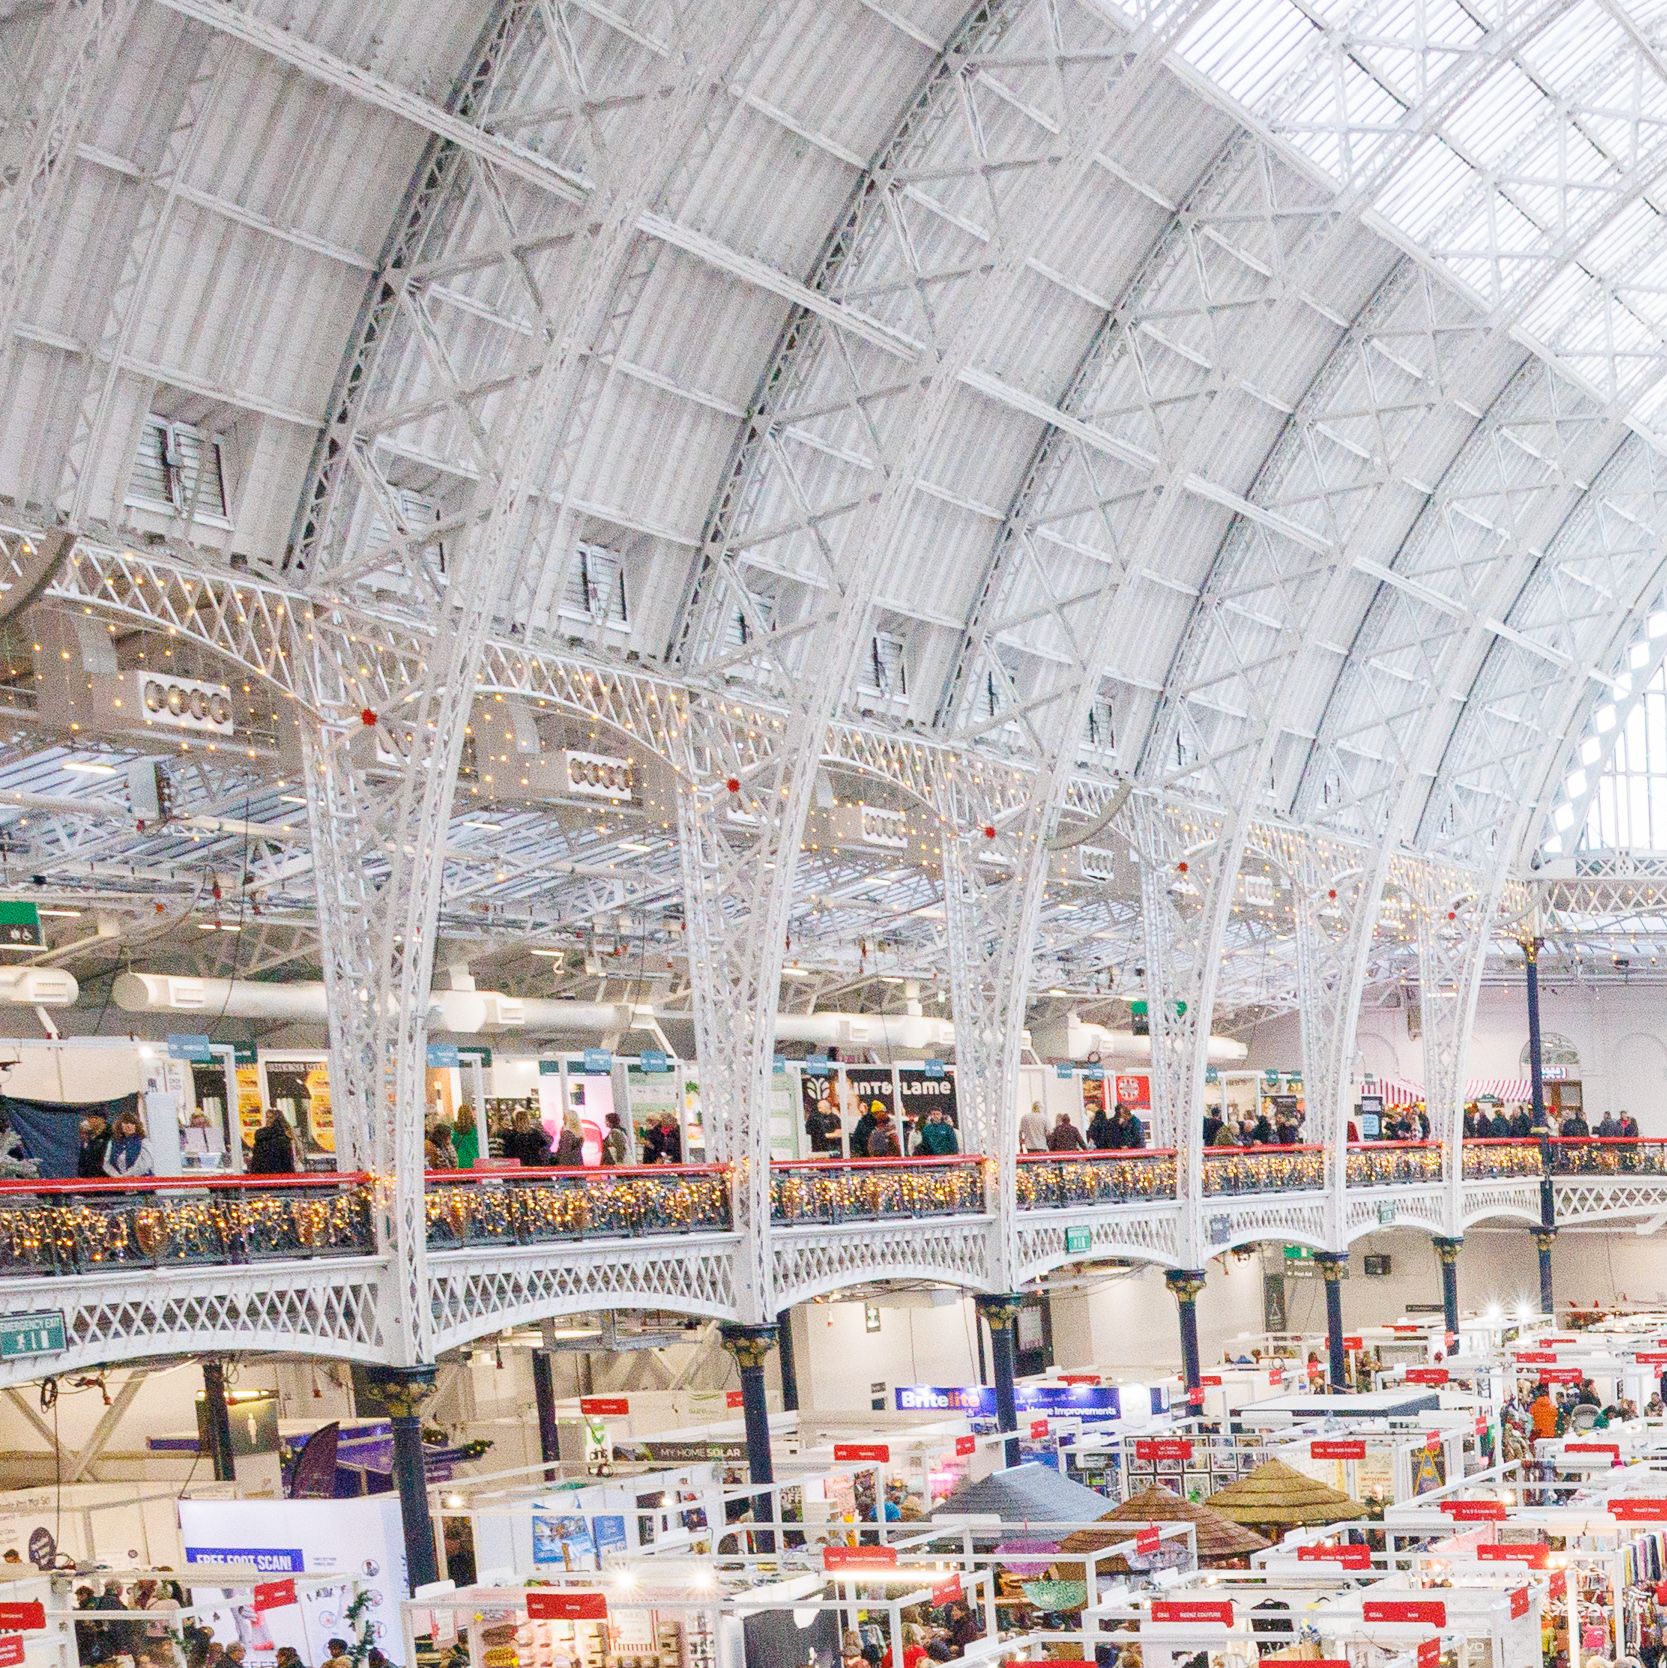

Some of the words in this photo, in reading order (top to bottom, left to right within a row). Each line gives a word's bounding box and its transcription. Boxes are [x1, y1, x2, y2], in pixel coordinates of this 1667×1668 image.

[901, 1391, 981, 1410] Britelite
[675, 1448, 706, 1458] HOME
[707, 1446, 741, 1457] SOLAR
[257, 1554, 293, 1571] SCAN!
